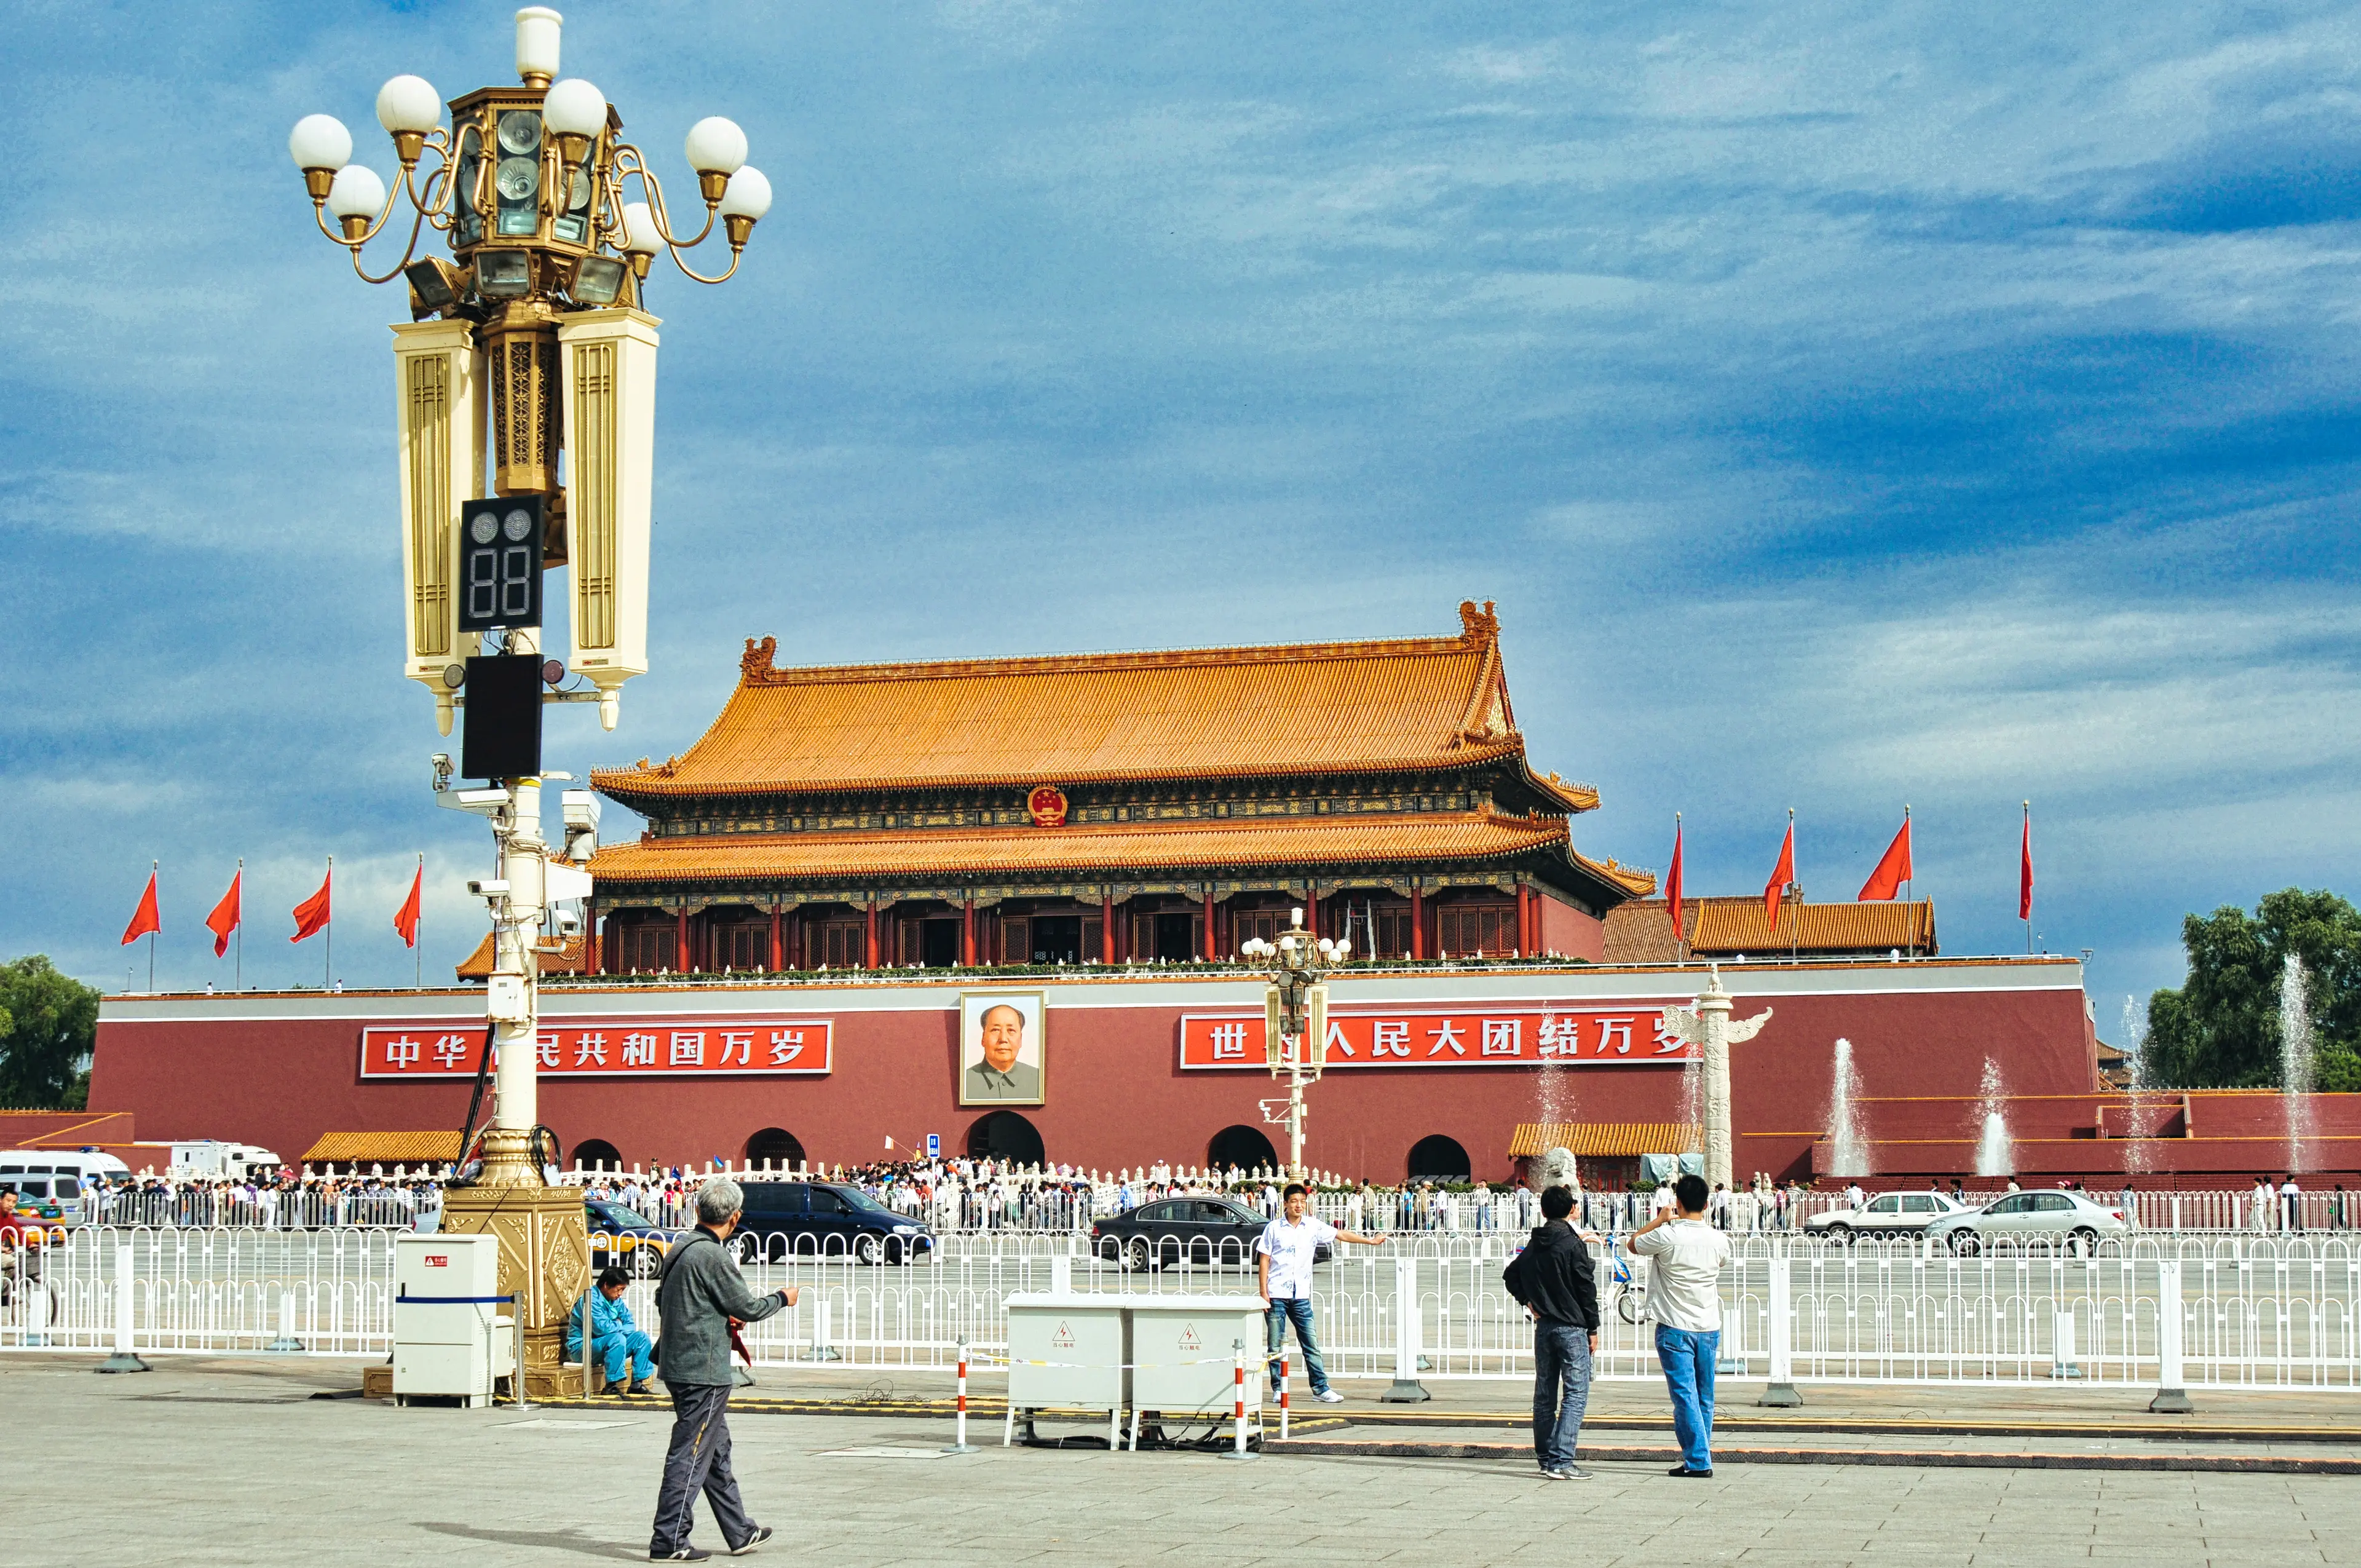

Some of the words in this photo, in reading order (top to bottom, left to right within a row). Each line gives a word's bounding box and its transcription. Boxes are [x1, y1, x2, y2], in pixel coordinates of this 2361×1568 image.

[386, 1031, 805, 1069] 中华民共和国万岁
[1210, 1017, 1688, 1060] 世人民大团结万岁
